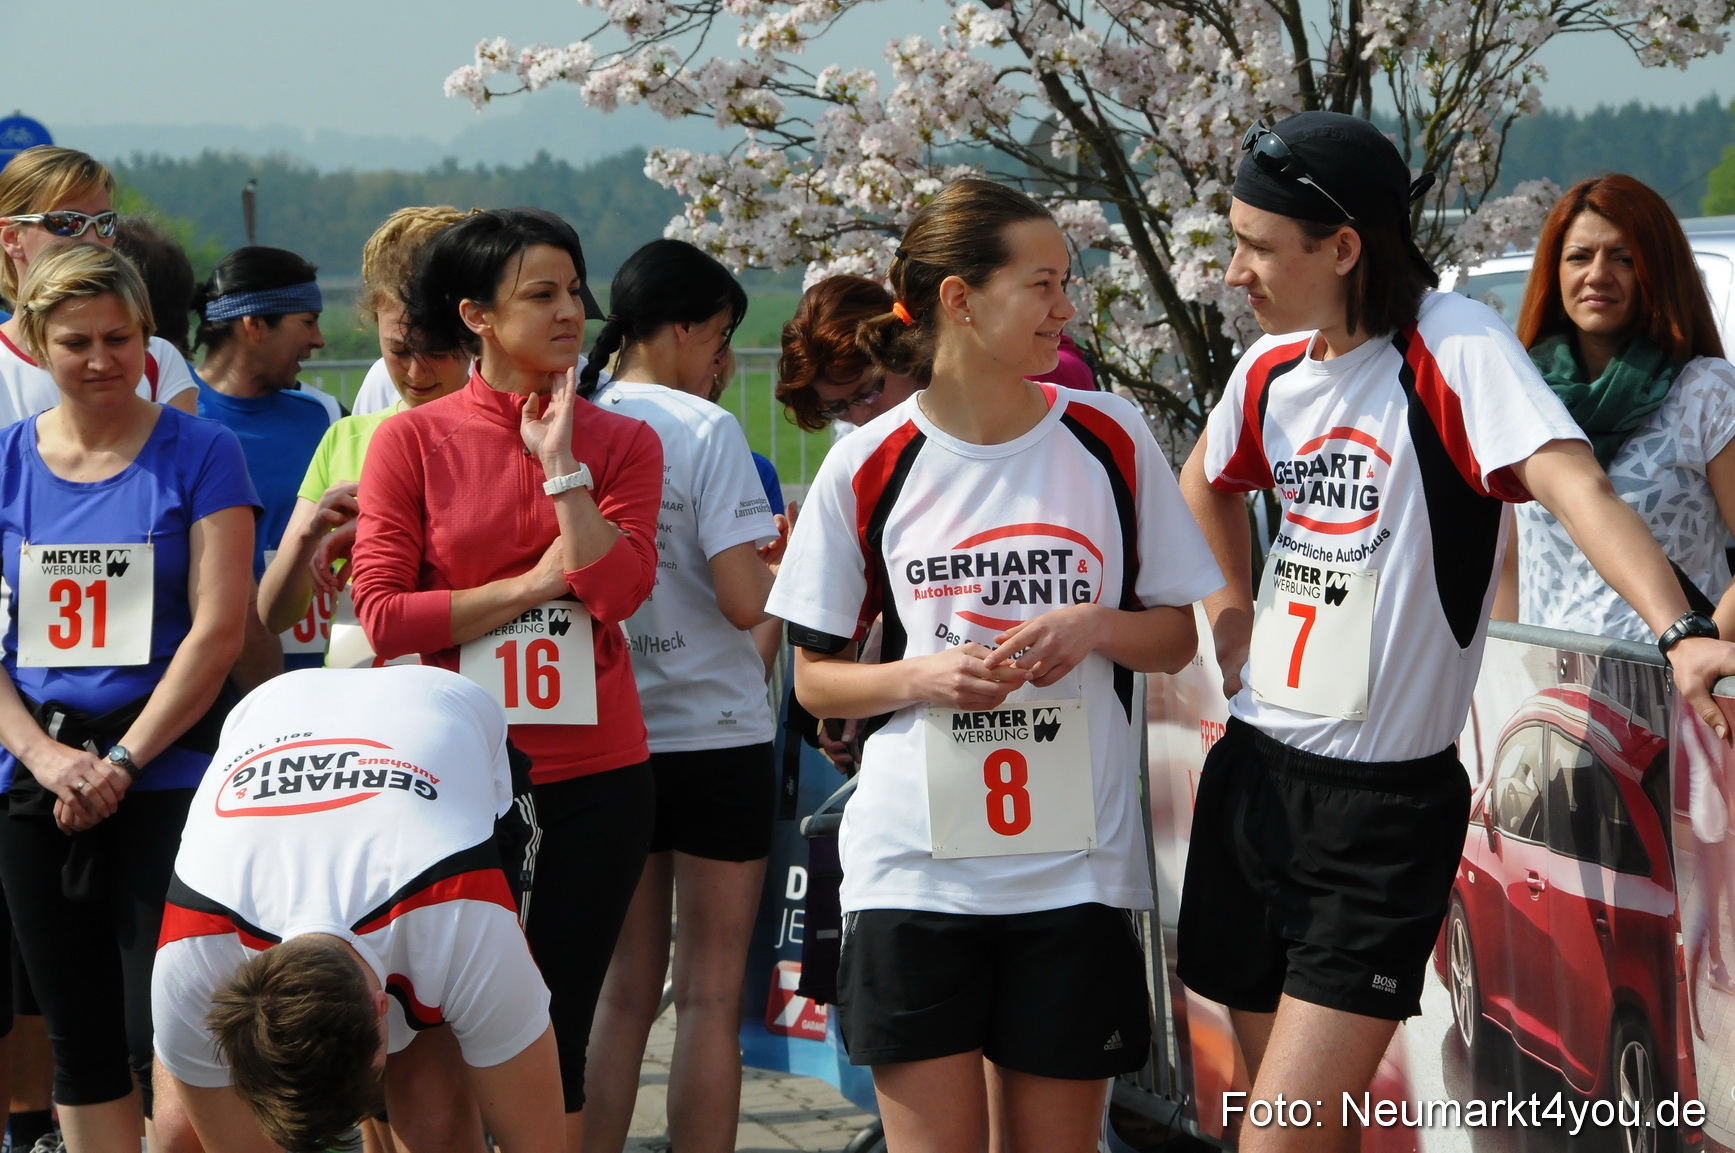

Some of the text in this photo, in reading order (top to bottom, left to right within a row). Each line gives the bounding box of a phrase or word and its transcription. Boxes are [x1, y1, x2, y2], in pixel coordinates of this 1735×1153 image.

[661, 501, 684, 512] MAR
[1290, 480, 1379, 511] JÄNIG
[41, 550, 101, 564] MEYER
[1277, 528, 1391, 563] sportliche Autohaus
[41, 564, 102, 575] WERBUNG
[906, 549, 1088, 585] GERHART &
[1274, 559, 1321, 586] MEYER
[914, 578, 1091, 606] Autohaus JÄNIG
[1273, 576, 1321, 599] WERBUNG
[48, 578, 106, 649] 31
[935, 623, 960, 646] Das
[1287, 600, 1317, 689] 7
[495, 638, 561, 710] 16
[952, 709, 1028, 731] MEYER
[952, 727, 1029, 744] WERBUNG
[232, 751, 440, 788] Autohaus JÄNIG
[253, 769, 438, 801] GERHART
[983, 748, 1032, 837] 8
[785, 865, 808, 900] D
[774, 908, 806, 949] JE
[1373, 974, 1397, 989] BOSS
